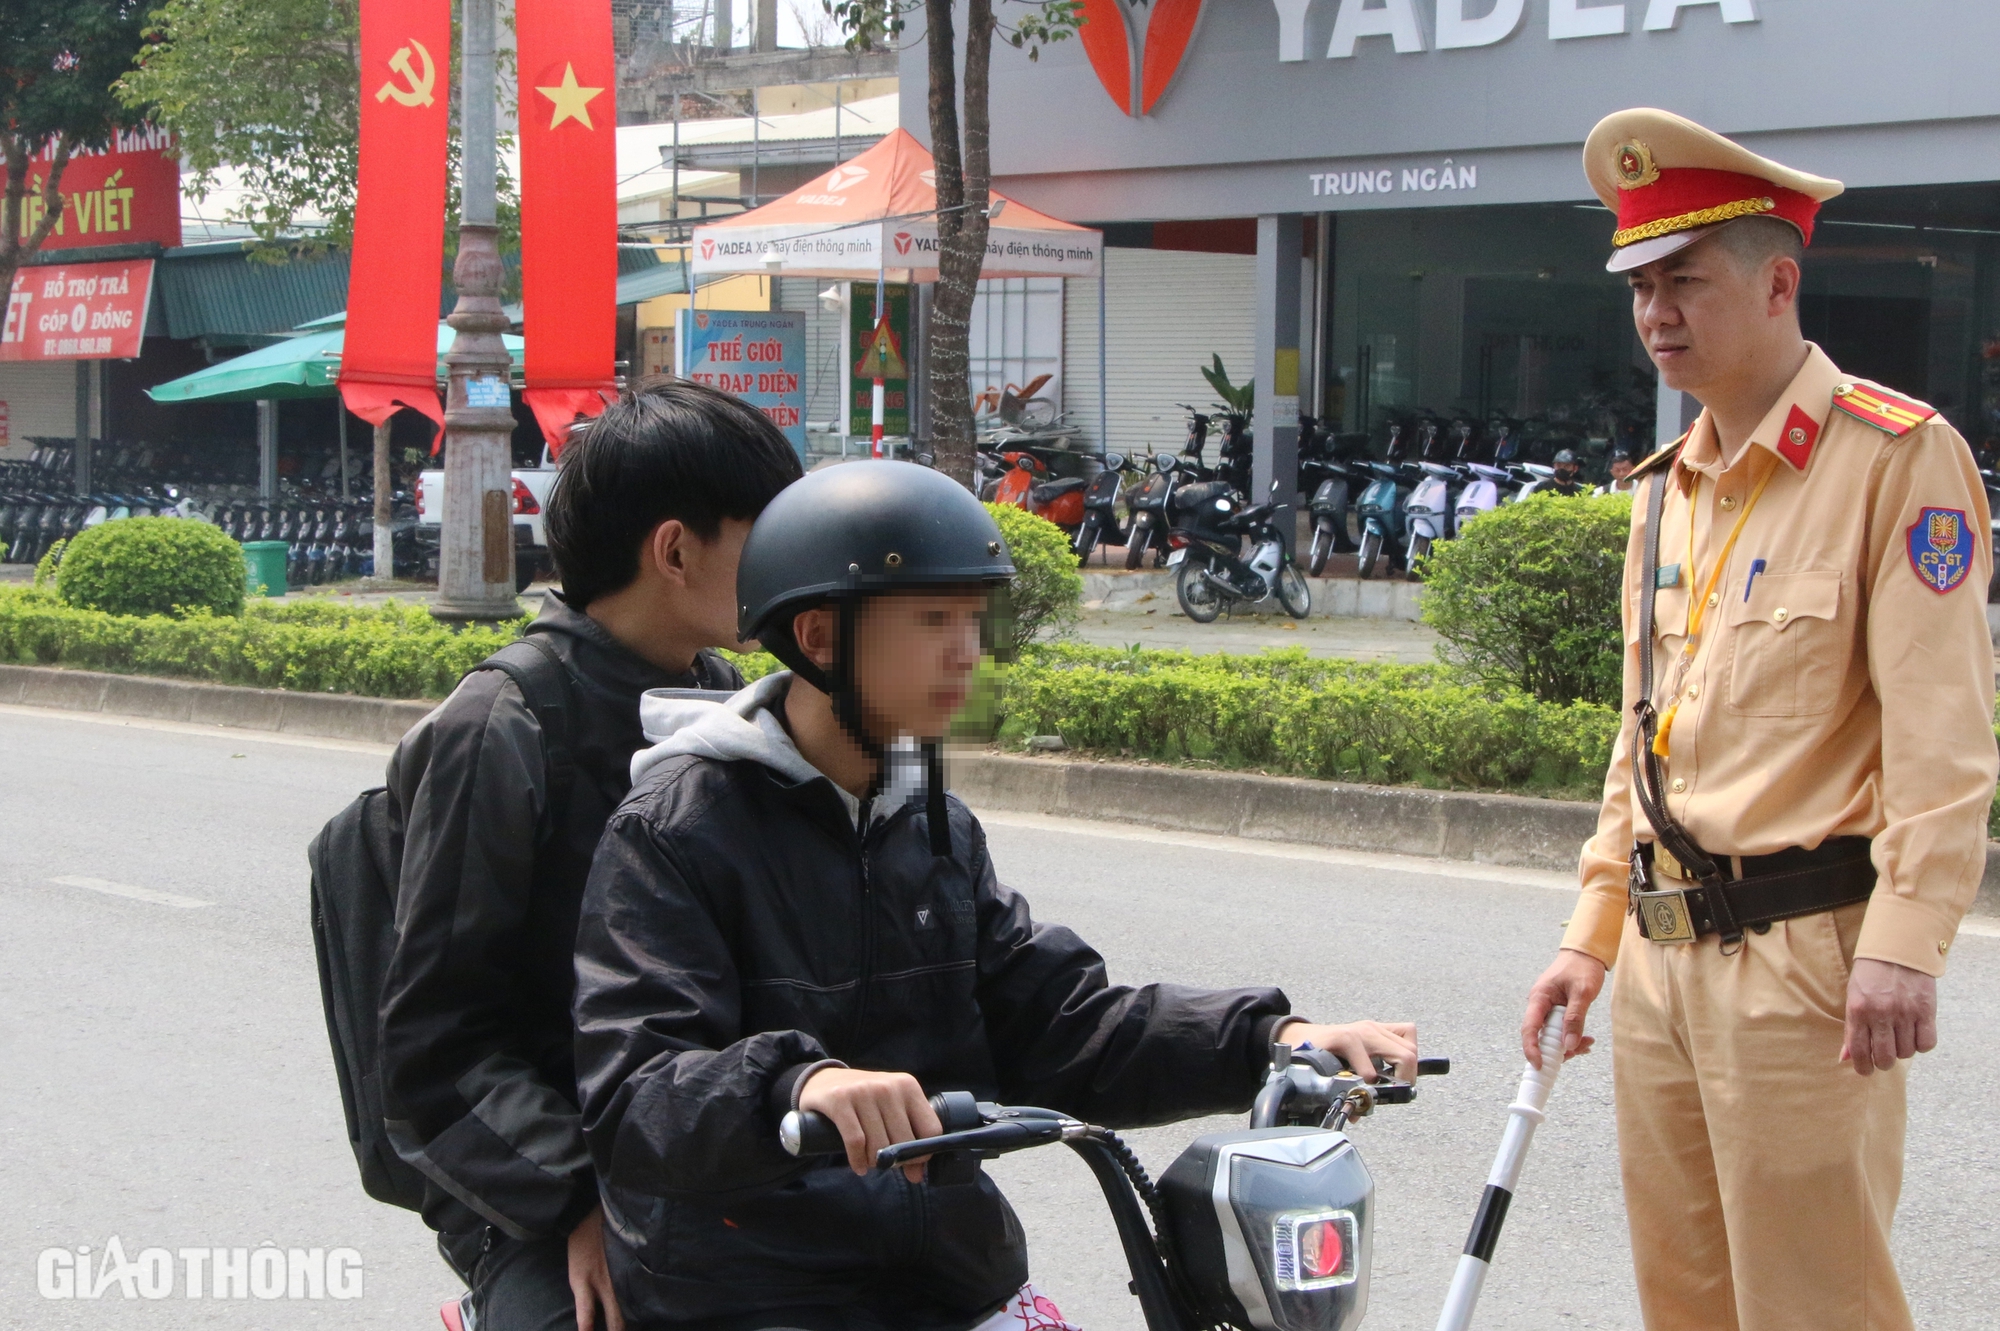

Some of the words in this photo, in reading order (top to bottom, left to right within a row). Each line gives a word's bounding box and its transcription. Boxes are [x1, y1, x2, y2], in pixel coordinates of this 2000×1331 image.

[1309, 169, 1393, 196] TRUNG
[1402, 158, 1477, 192] NGÂN
[73, 168, 134, 234] VIẾT
[796, 195, 847, 207] YADEA
[717, 241, 753, 255] YADEA
[793, 239, 813, 256] điện
[816, 239, 844, 256] thông
[847, 238, 872, 253] minh
[915, 238, 939, 251] YAD
[1007, 241, 1030, 259] điện
[1032, 243, 1064, 261] thông
[1067, 246, 1093, 260] minh
[43, 271, 65, 298] HỖ
[68, 275, 98, 301] TRỢ
[100, 269, 130, 296] TRẢ
[39, 309, 69, 332] GÓP
[712, 319, 738, 328] YADEA
[741, 319, 767, 328] TRUNG
[707, 333, 743, 362] THẾ
[747, 337, 783, 362] GIỚI
[758, 368, 799, 398] ĐIỆN
[1921, 552, 1939, 564] CS
[1946, 553, 1962, 566] GT
